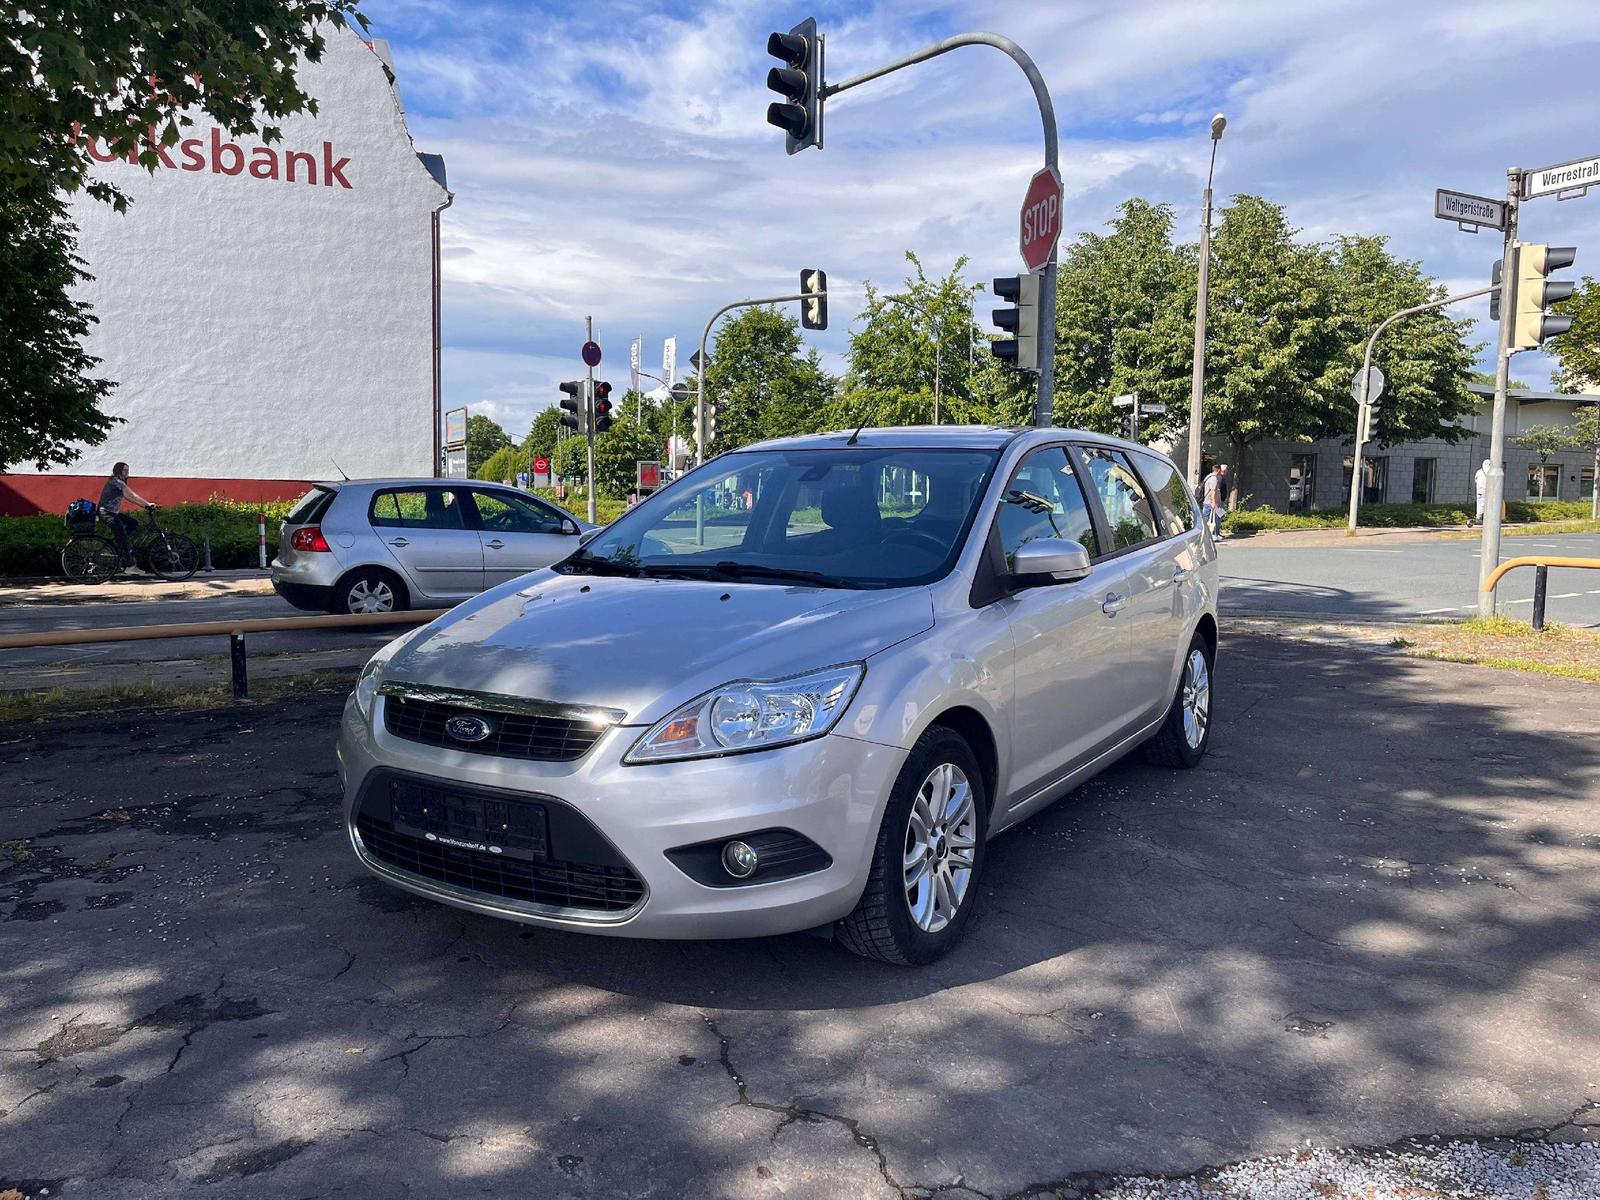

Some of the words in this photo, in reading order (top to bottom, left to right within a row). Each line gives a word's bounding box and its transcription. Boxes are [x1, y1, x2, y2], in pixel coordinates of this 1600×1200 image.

[54, 112, 353, 189] olksbank
[1023, 194, 1057, 246] STOP
[1445, 196, 1494, 219] Waltgeristraße
[453, 720, 477, 736] Ford
